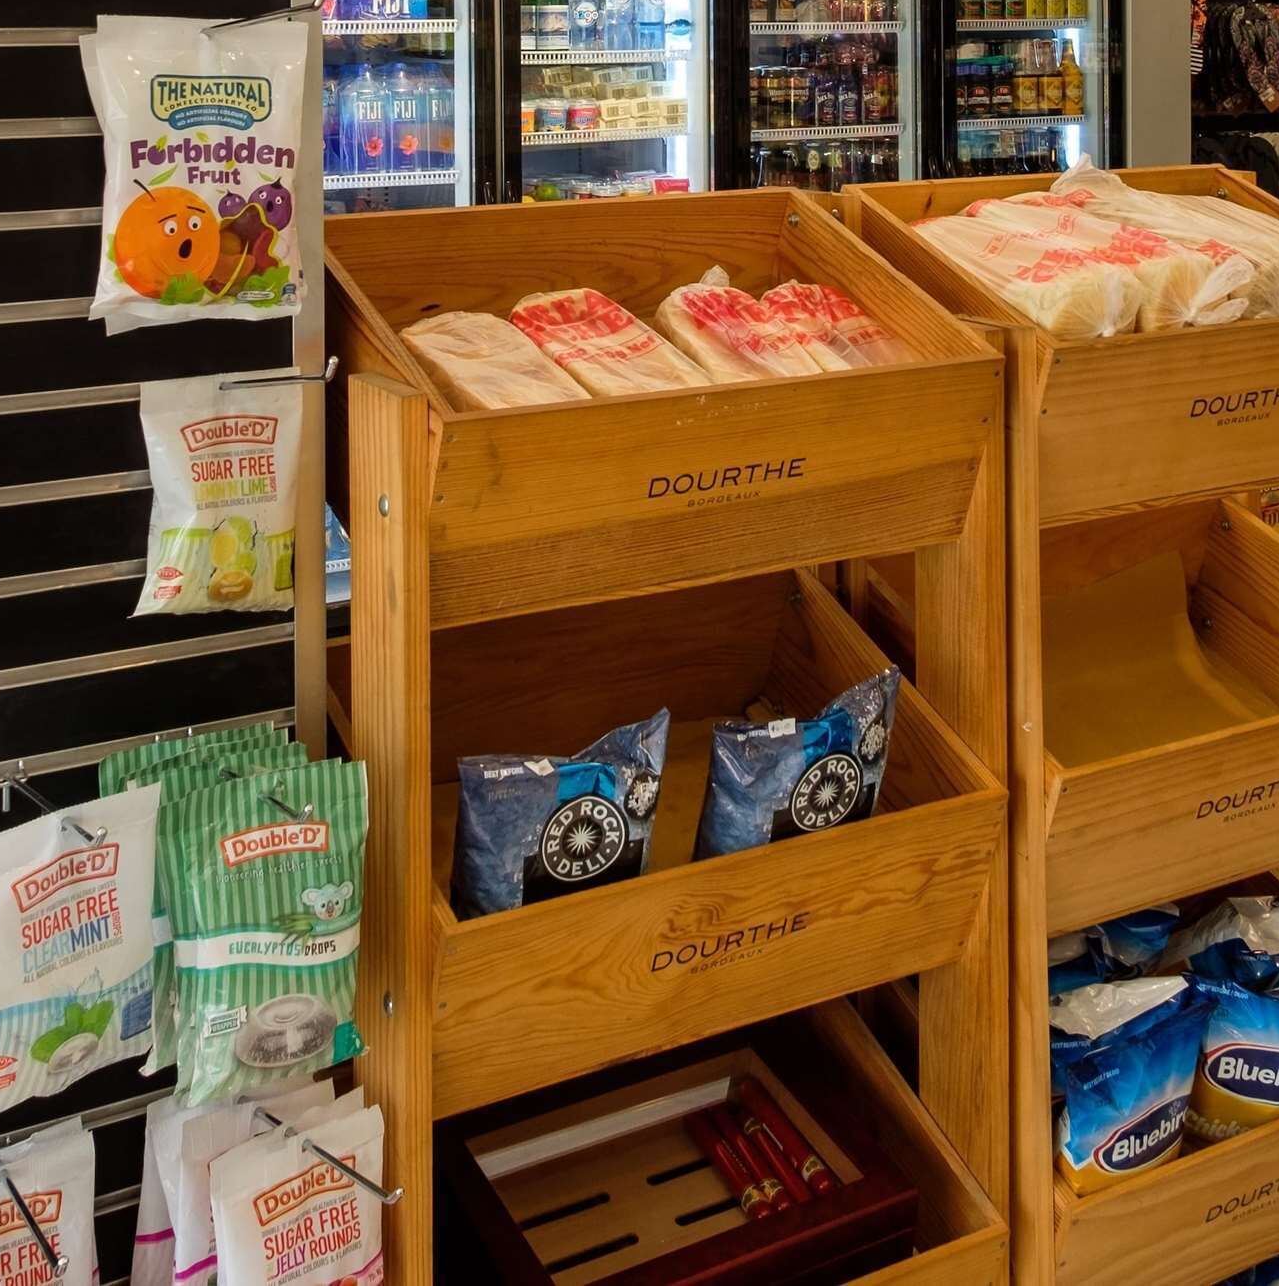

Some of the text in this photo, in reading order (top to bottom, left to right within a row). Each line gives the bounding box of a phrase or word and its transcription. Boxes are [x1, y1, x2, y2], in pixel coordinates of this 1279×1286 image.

[157, 81, 265, 107] THE NATURAL
[164, 97, 242, 112] CONFECTIONERY
[357, 100, 384, 121] FIJI
[393, 100, 417, 120] FIJI
[130, 137, 295, 169] Forbidden
[187, 166, 240, 185] Fruit
[191, 455, 275, 482] SUGAR FREE
[648, 458, 806, 498] DOURTHE
[240, 477, 269, 496] LIME
[796, 759, 856, 807] RED ROCK
[548, 801, 620, 854] RED ROCK
[803, 804, 845, 828] DELI
[557, 854, 608, 877] DELI
[22, 888, 119, 949] SUGAR FREE
[651, 912, 810, 973] DOURTHE
[264, 1197, 359, 1260] SUGAR FREE
[18, 1233, 61, 1269] FRE
[270, 1221, 360, 1279] JELLY ROUNDS
